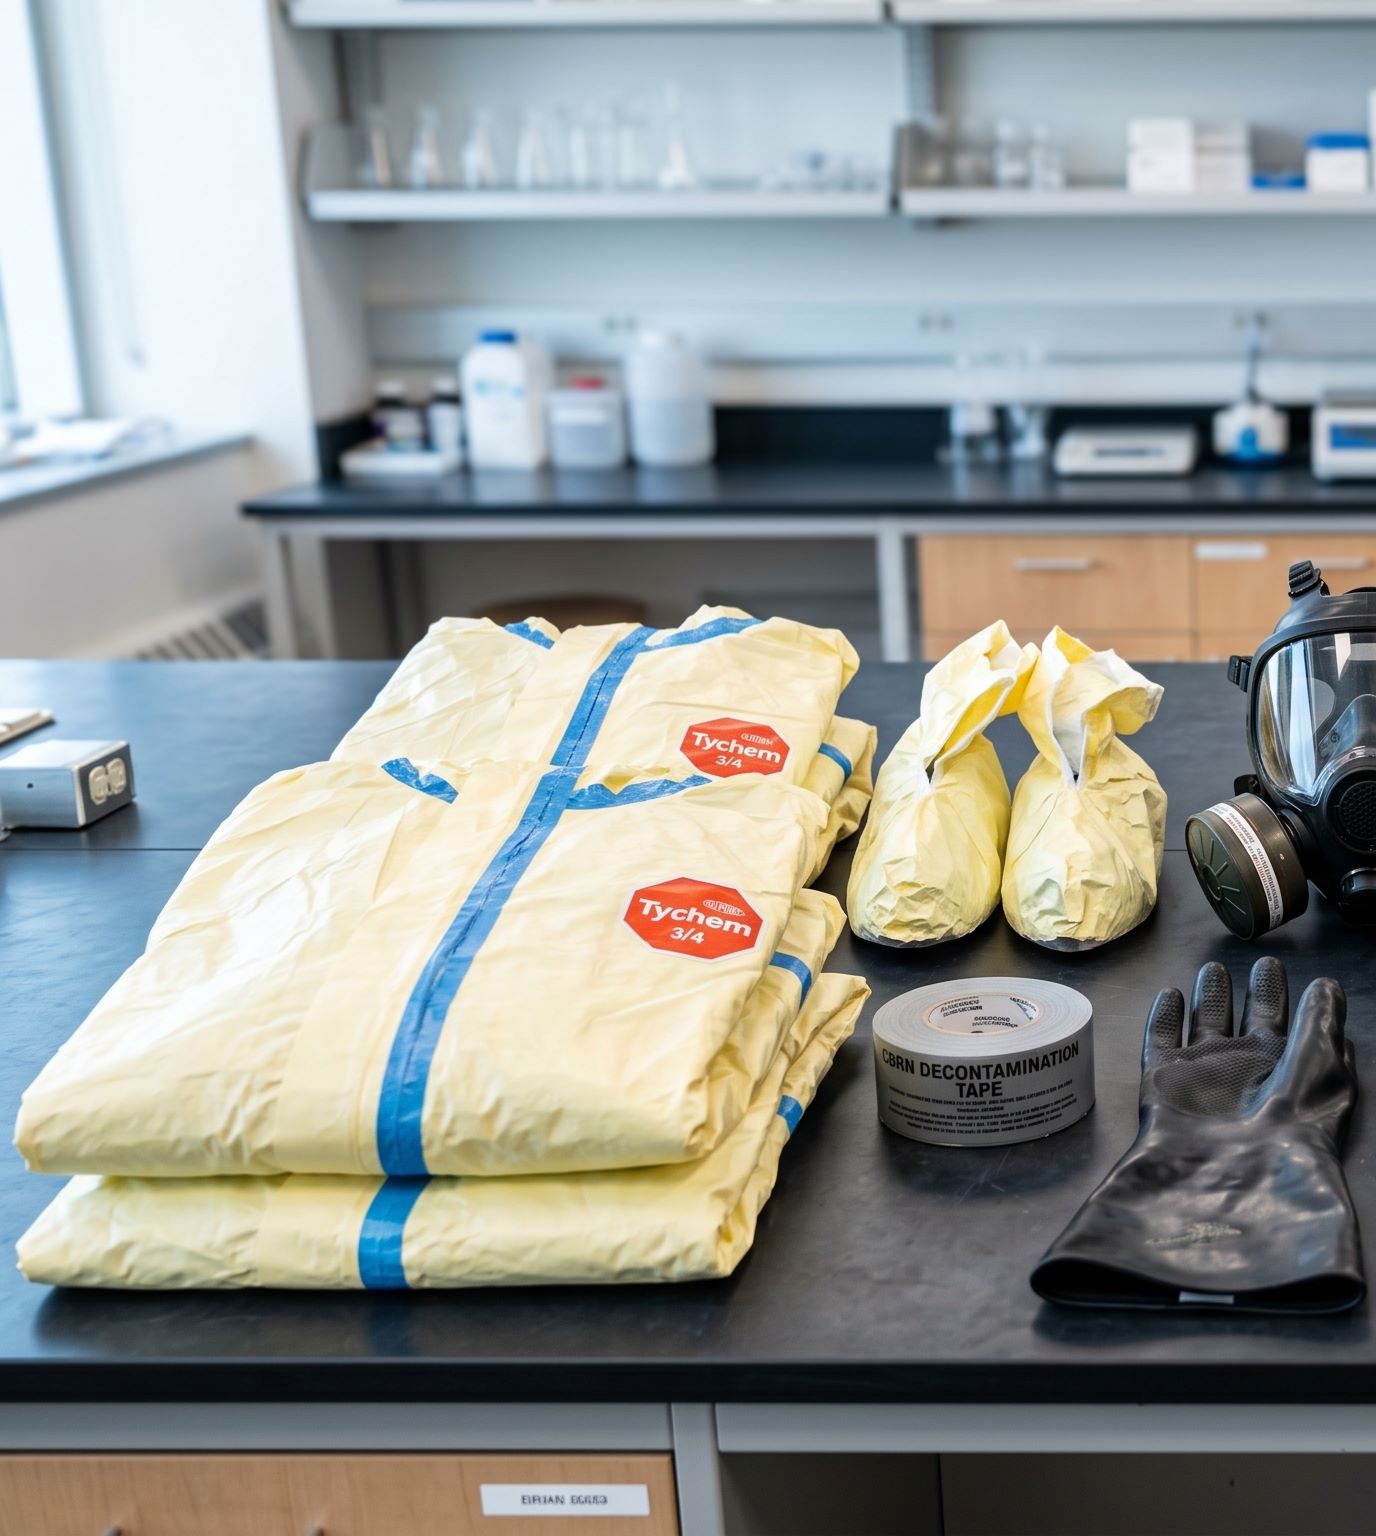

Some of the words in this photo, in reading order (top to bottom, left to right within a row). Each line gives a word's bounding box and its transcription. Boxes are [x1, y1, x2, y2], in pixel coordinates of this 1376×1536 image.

[692, 731, 781, 763] Tychem
[715, 755, 742, 769] 3/4
[639, 898, 751, 937] Tychem
[670, 927, 704, 944] 3/4
[882, 1048, 915, 1075] CBRN
[919, 1040, 1080, 1080] DECONTAMINATION
[955, 1081, 1003, 1098] TAPE
